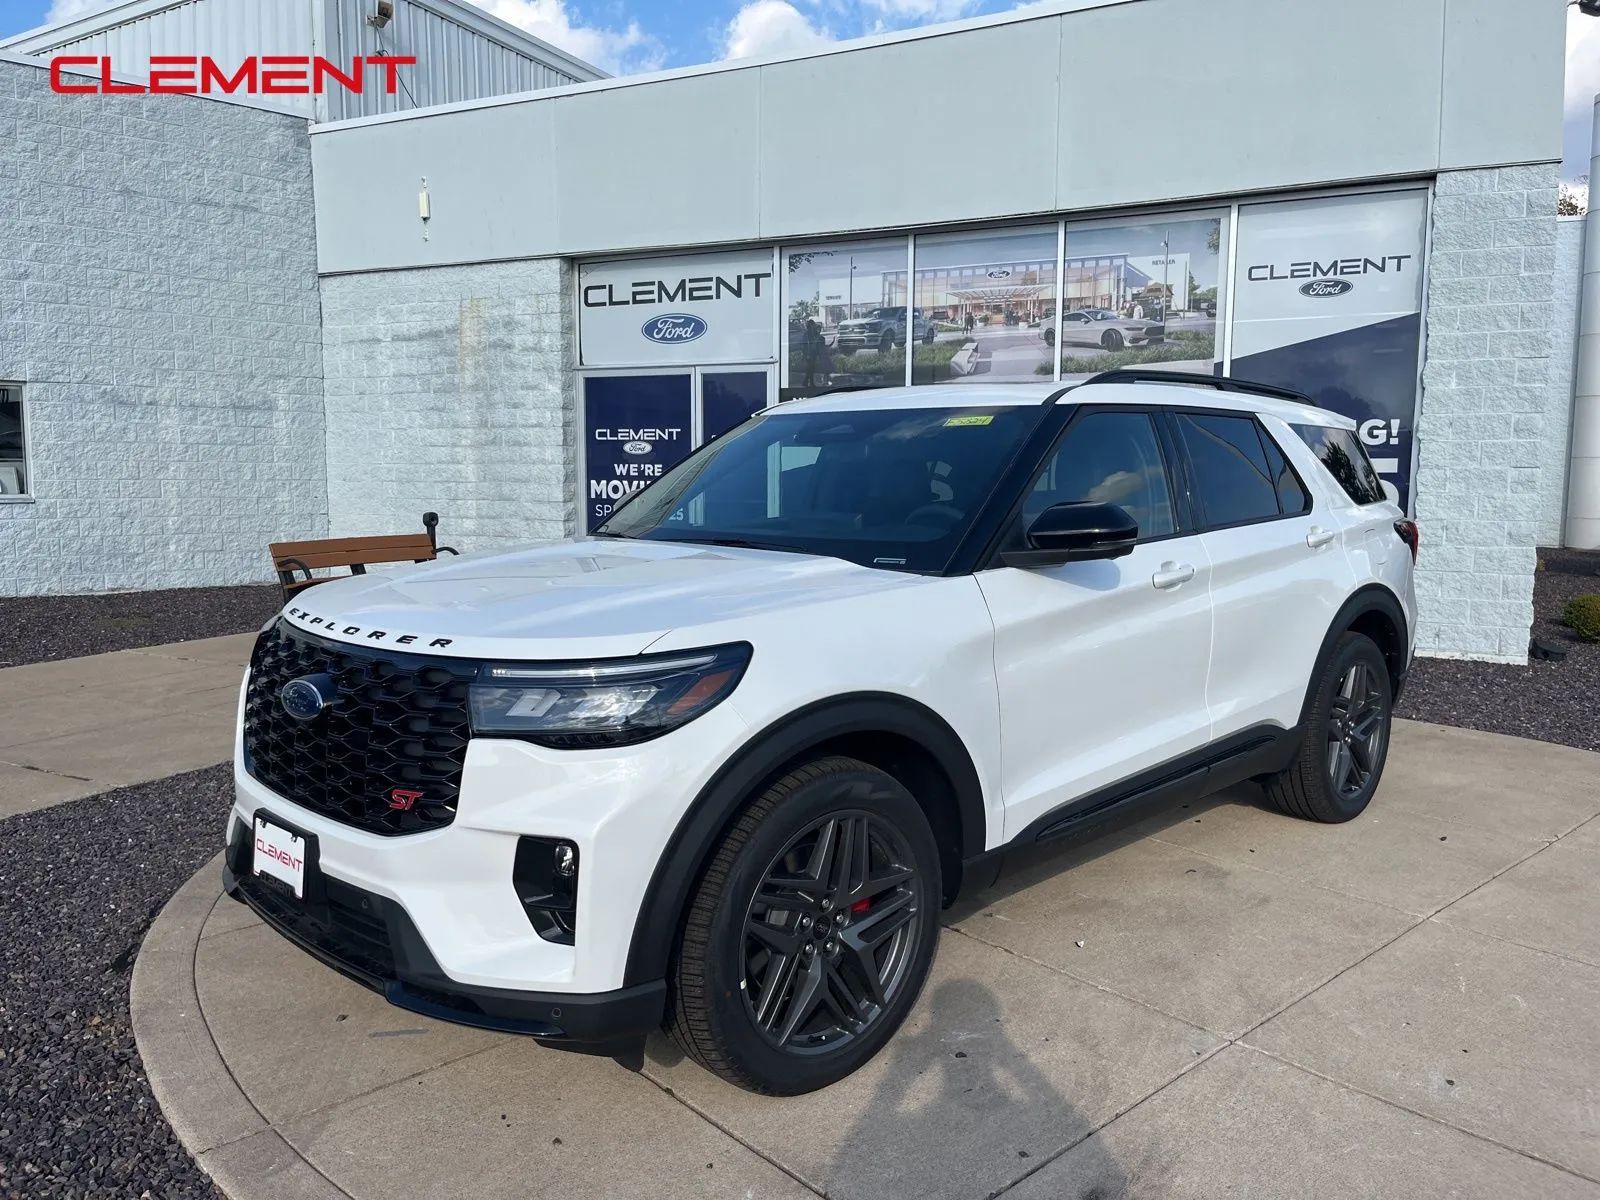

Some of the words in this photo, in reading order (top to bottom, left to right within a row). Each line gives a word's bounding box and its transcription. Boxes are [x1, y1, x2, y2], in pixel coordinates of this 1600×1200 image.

[1247, 254, 1412, 282] CLEMENT
[583, 272, 772, 308] CLEMENT
[595, 428, 681, 441] CLEMENT
[1358, 418, 1400, 446] G!
[613, 463, 663, 477] WE'RE
[590, 479, 652, 500] MOV
[288, 607, 453, 648] EXPLORER
[389, 789, 425, 811] ST
[256, 838, 303, 873] CLEMENT
